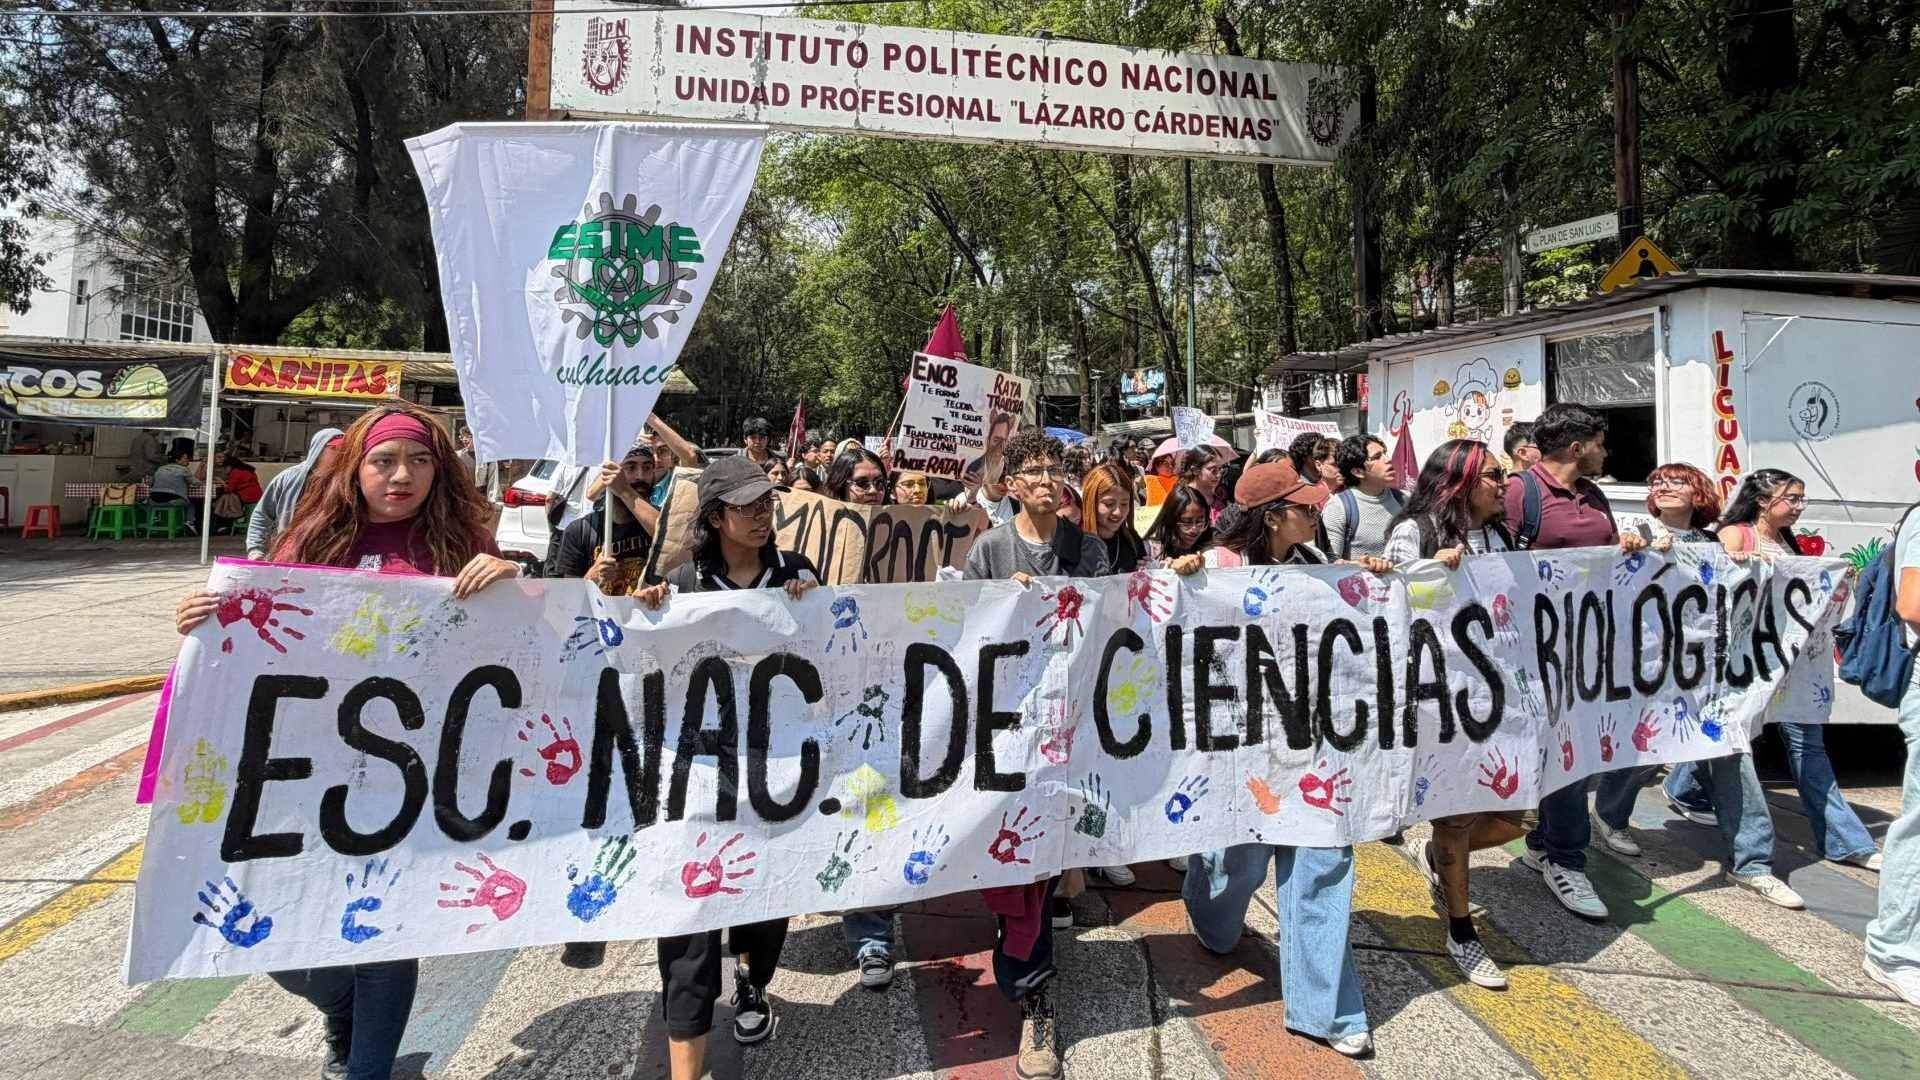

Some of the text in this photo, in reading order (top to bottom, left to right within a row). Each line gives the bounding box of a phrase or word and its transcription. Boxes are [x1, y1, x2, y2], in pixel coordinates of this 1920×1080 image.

[676, 24, 1277, 100] INSTITUTO POLITÉCNICO NACIONAL
[675, 75, 790, 107] UNIDAD
[801, 85, 1001, 122] PROFESIONAL
[548, 223, 704, 263] ESIME
[1540, 231, 1557, 246] PLAN
[1558, 230, 1568, 241] DE
[1569, 227, 1584, 239] SAN
[1585, 223, 1601, 236] LUIS
[231, 354, 388, 394] CARNITAS
[912, 355, 958, 389] ENCB
[921, 383, 934, 394] TE
[994, 373, 1021, 398] RATA
[945, 399, 954, 409] TE
[931, 416, 948, 430] TE
[221, 562, 1815, 863] ESC. NAC. DE CIENCIAS BIOLÓGICAS
